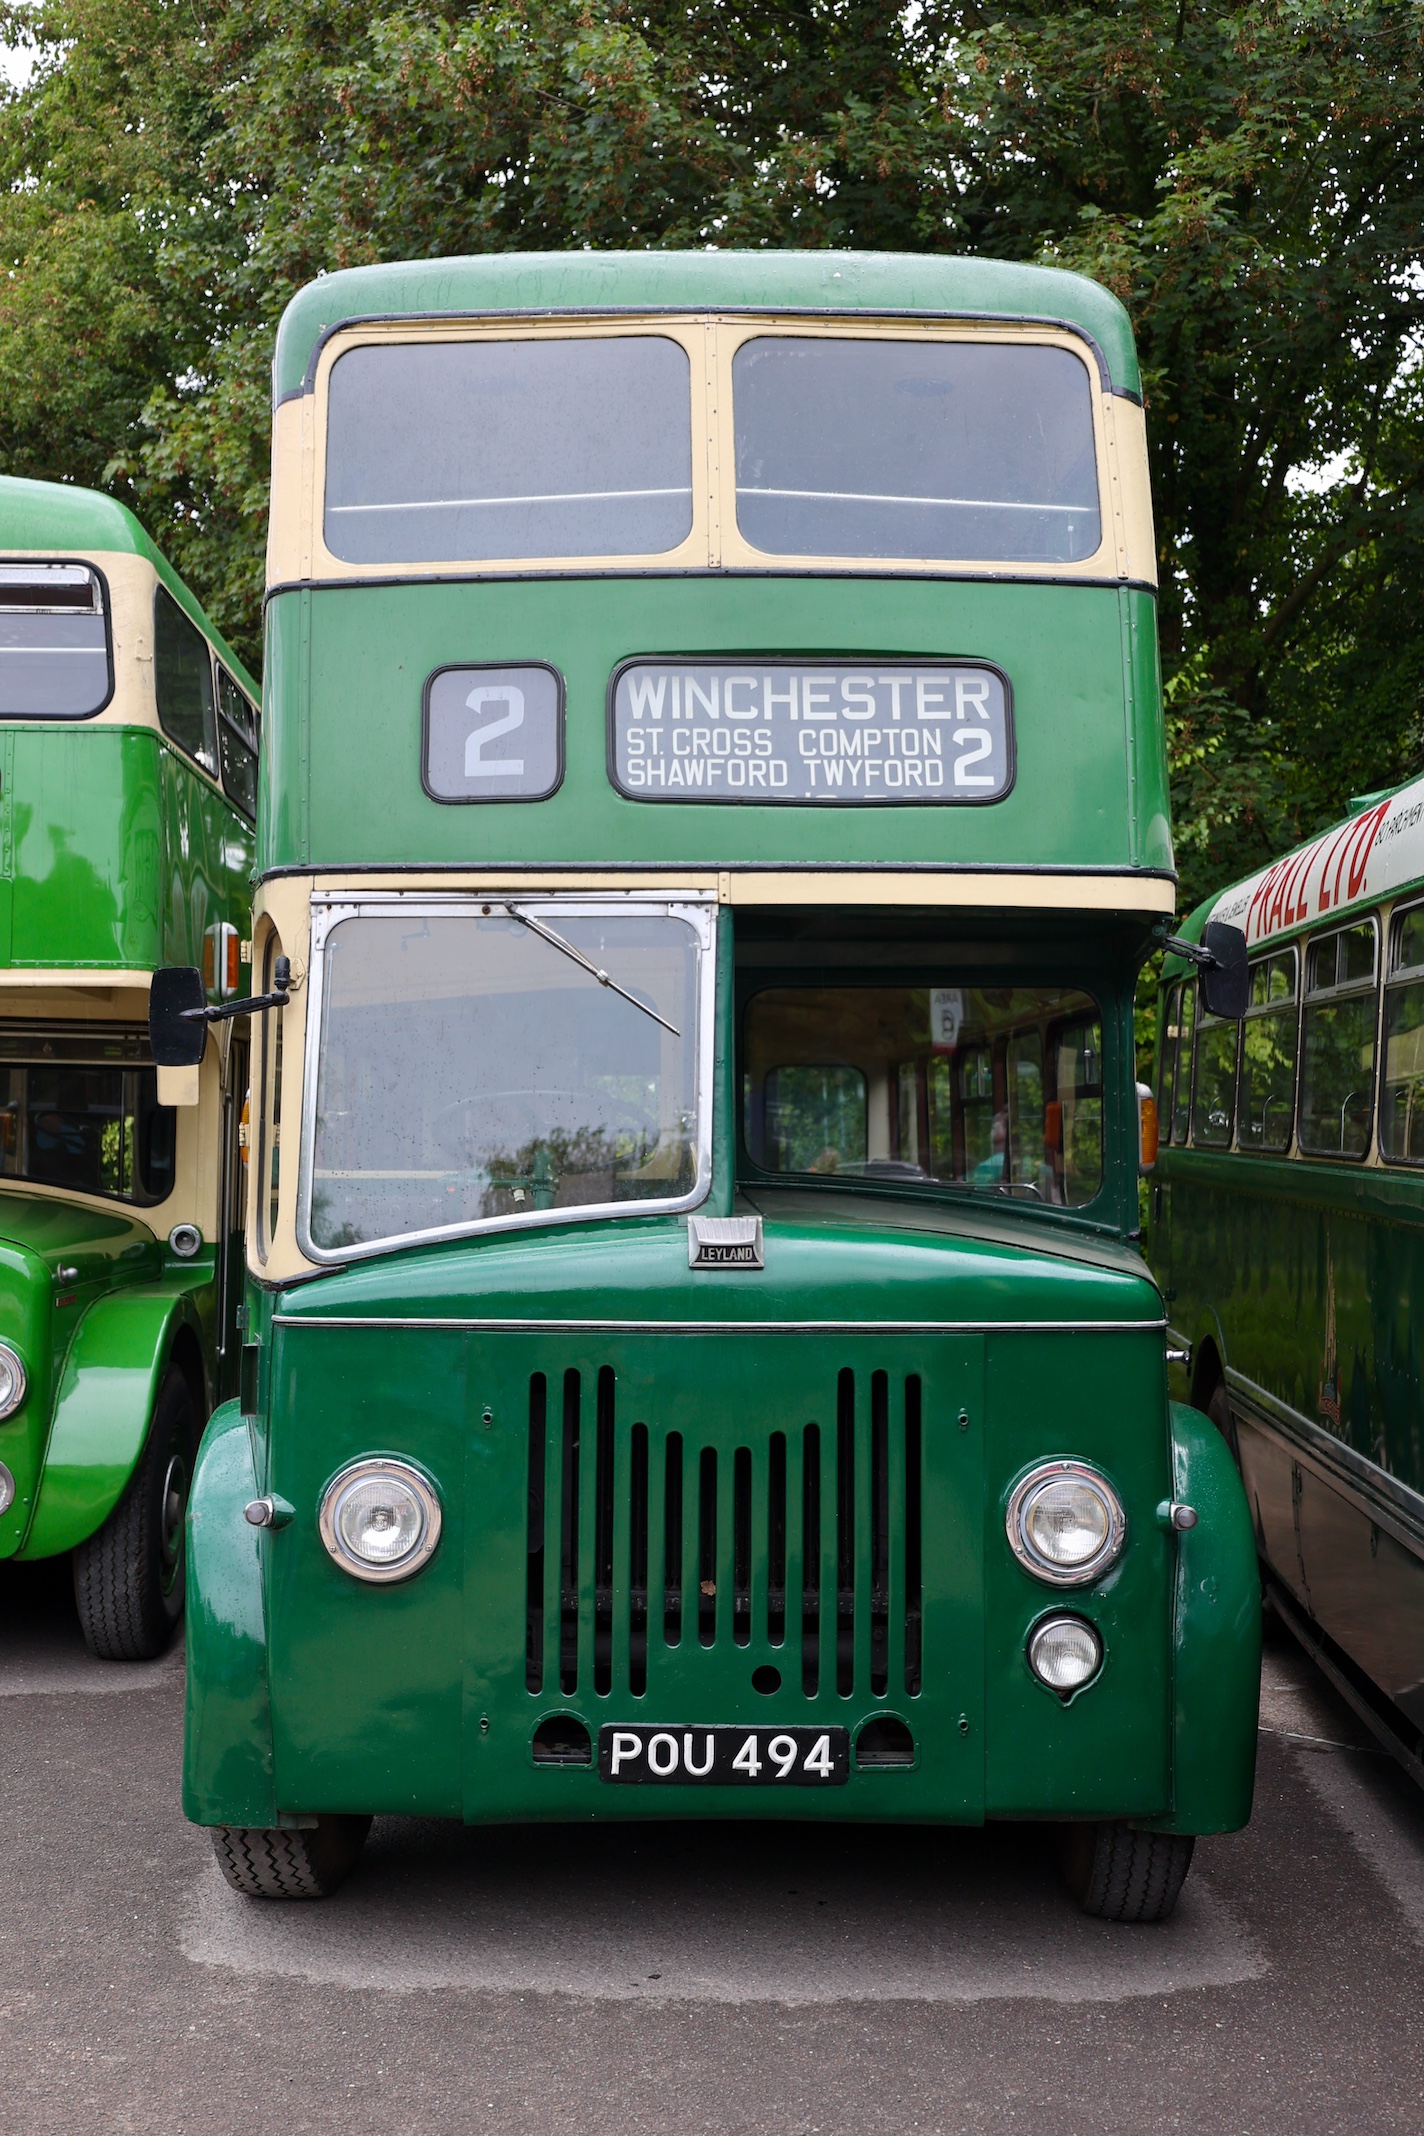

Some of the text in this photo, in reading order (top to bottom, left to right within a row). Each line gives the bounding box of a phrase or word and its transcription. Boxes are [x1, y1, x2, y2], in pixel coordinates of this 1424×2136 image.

[627, 676, 991, 719] WINCHESTER
[464, 685, 525, 777] 2
[626, 727, 995, 786] ST. CROSS COMPTON 2
[626, 759, 944, 786] SHAWFORD TWYFORD
[1245, 833, 1331, 943] PRALL
[702, 1247, 752, 1260] LEYLAND
[611, 1732, 835, 1778] POU 494
